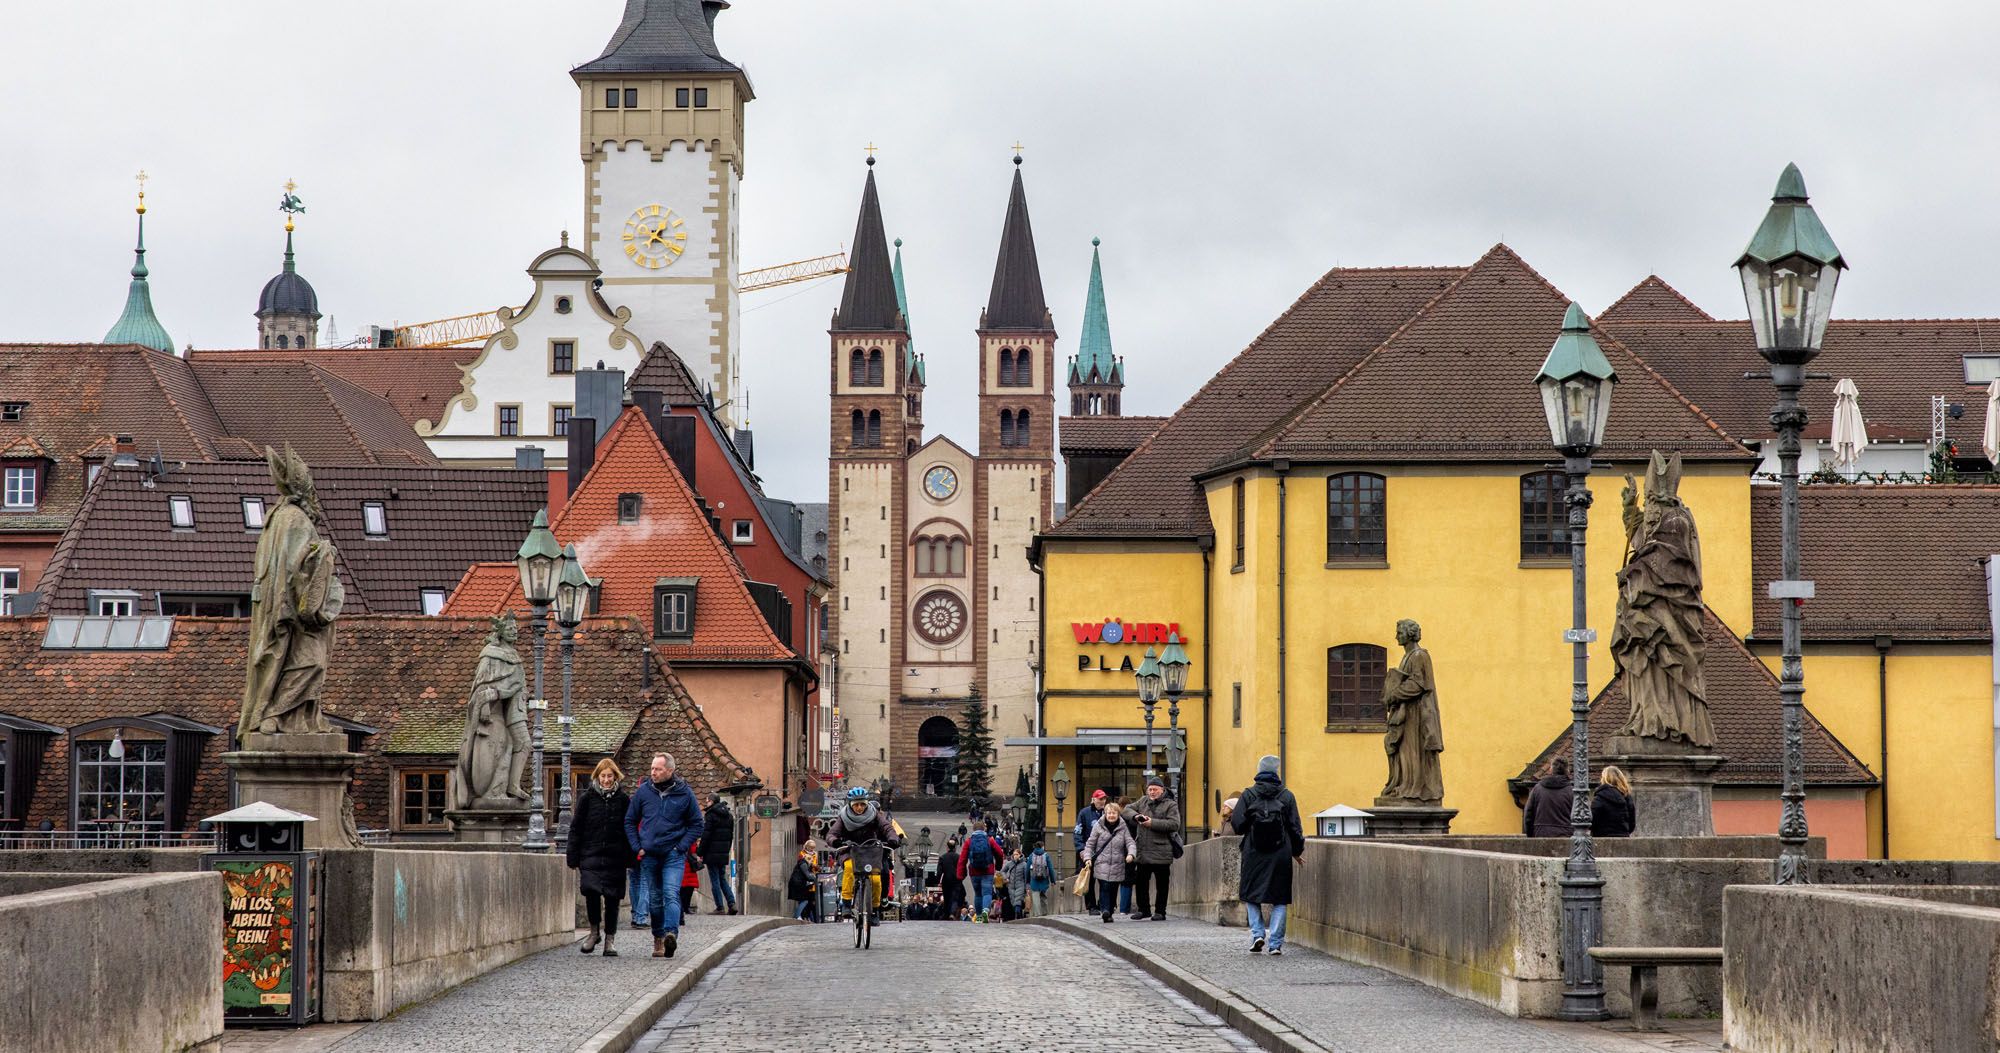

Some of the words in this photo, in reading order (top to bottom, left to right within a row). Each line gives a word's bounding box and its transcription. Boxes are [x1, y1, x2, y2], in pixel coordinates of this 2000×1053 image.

[1071, 617, 1188, 645] WÖHRL
[1078, 655, 1134, 672] PLA
[832, 715, 840, 776] APOTHEKE
[229, 897, 247, 911] NA
[249, 897, 275, 912] LOS,
[231, 913, 273, 927] ABFALL
[236, 929, 270, 944] REIN!
